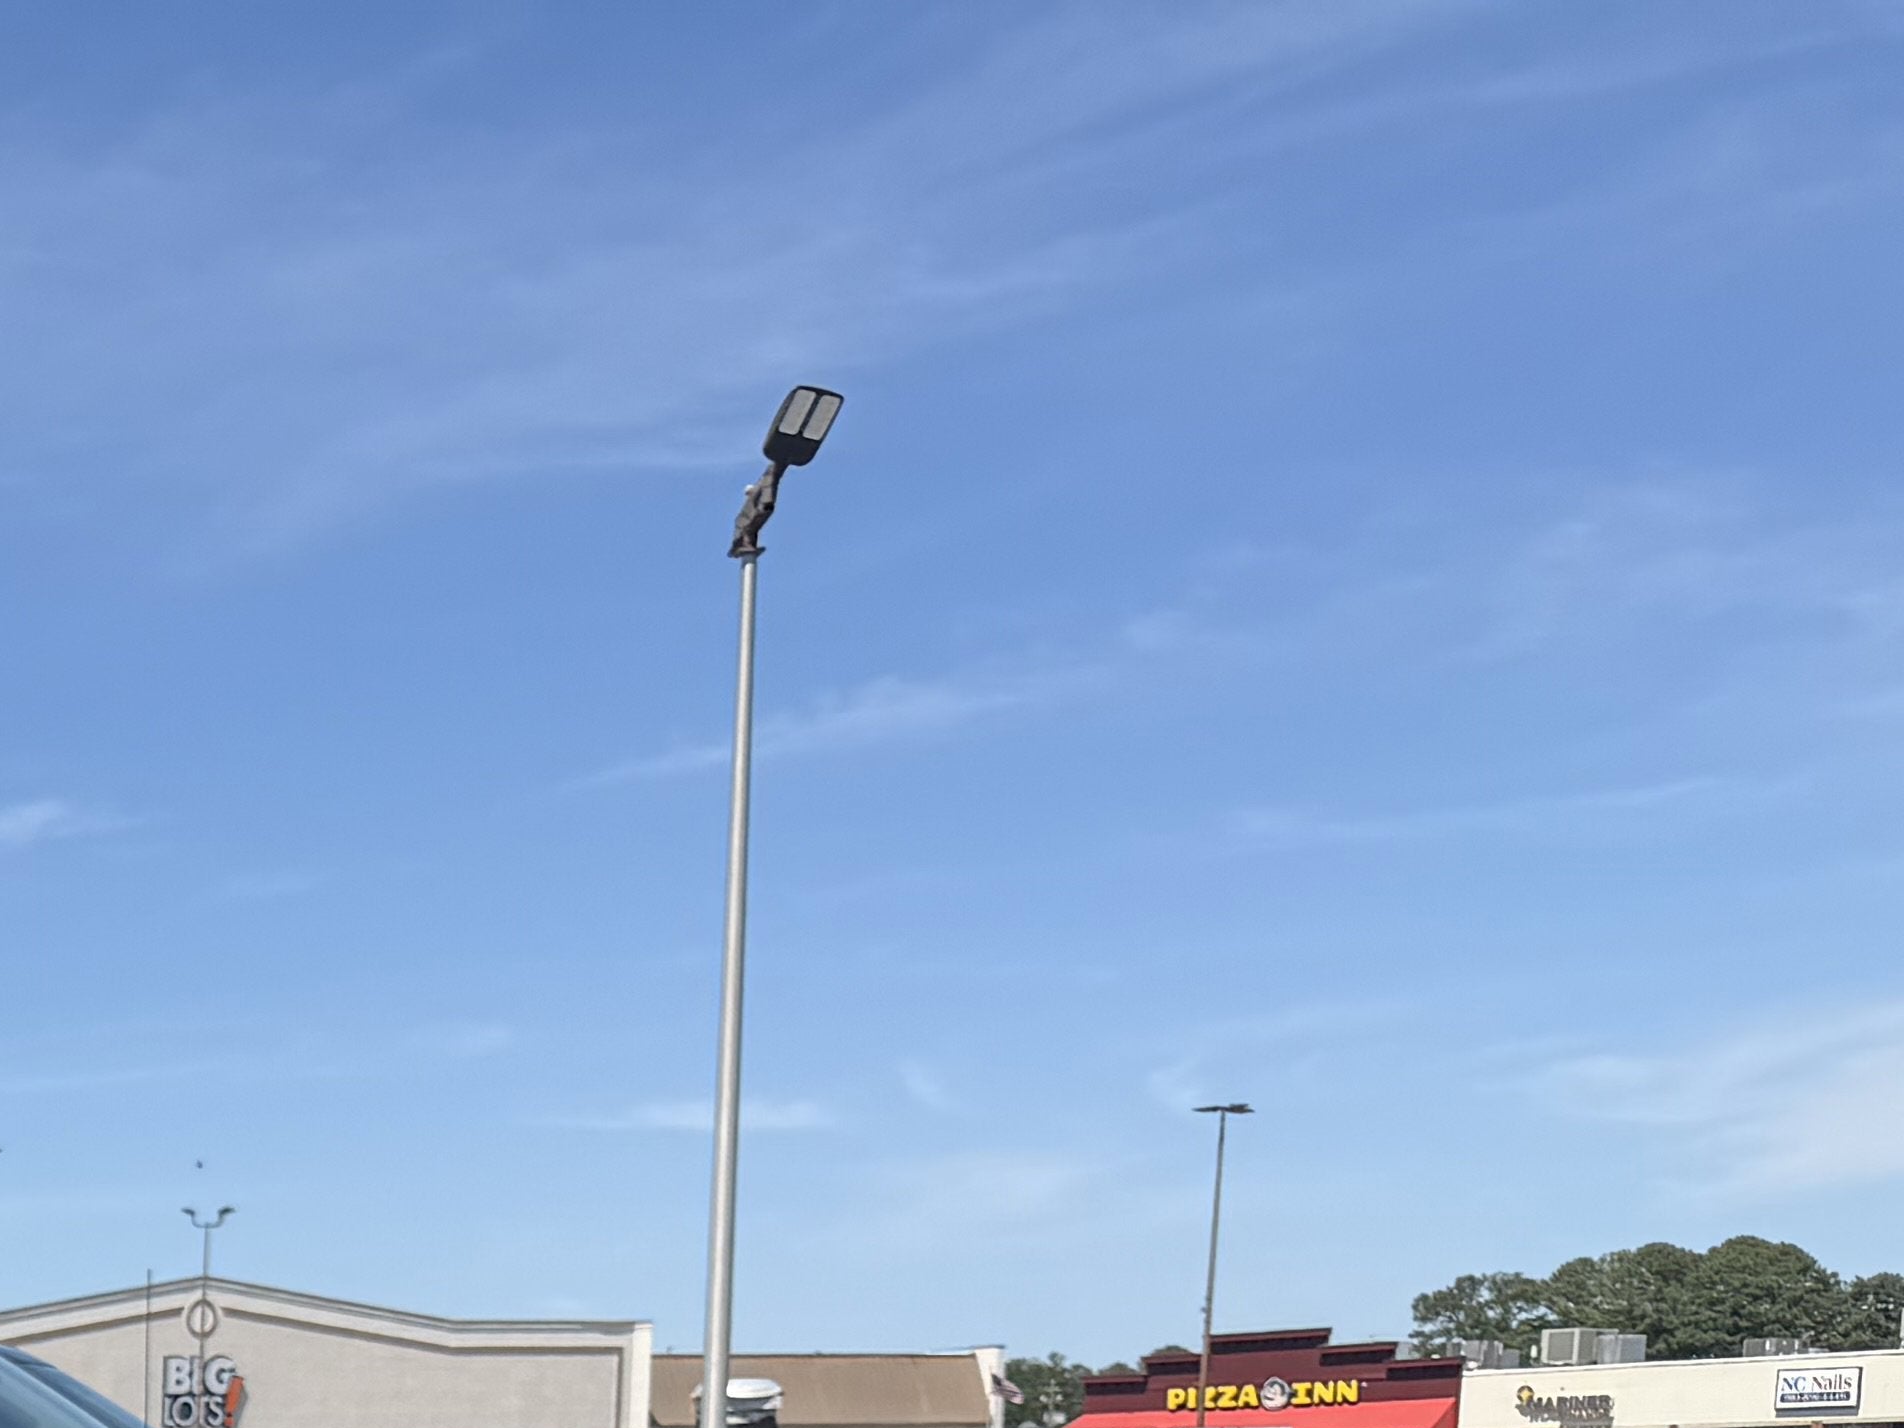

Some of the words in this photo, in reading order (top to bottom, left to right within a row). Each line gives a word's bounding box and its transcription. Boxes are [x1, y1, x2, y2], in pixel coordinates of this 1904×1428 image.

[163, 1356, 236, 1395] BIG
[1781, 1376, 1806, 1392] NC
[1812, 1374, 1853, 1392] Nails
[1290, 1379, 1359, 1406] INN
[1530, 1395, 1612, 1411] MARINER
